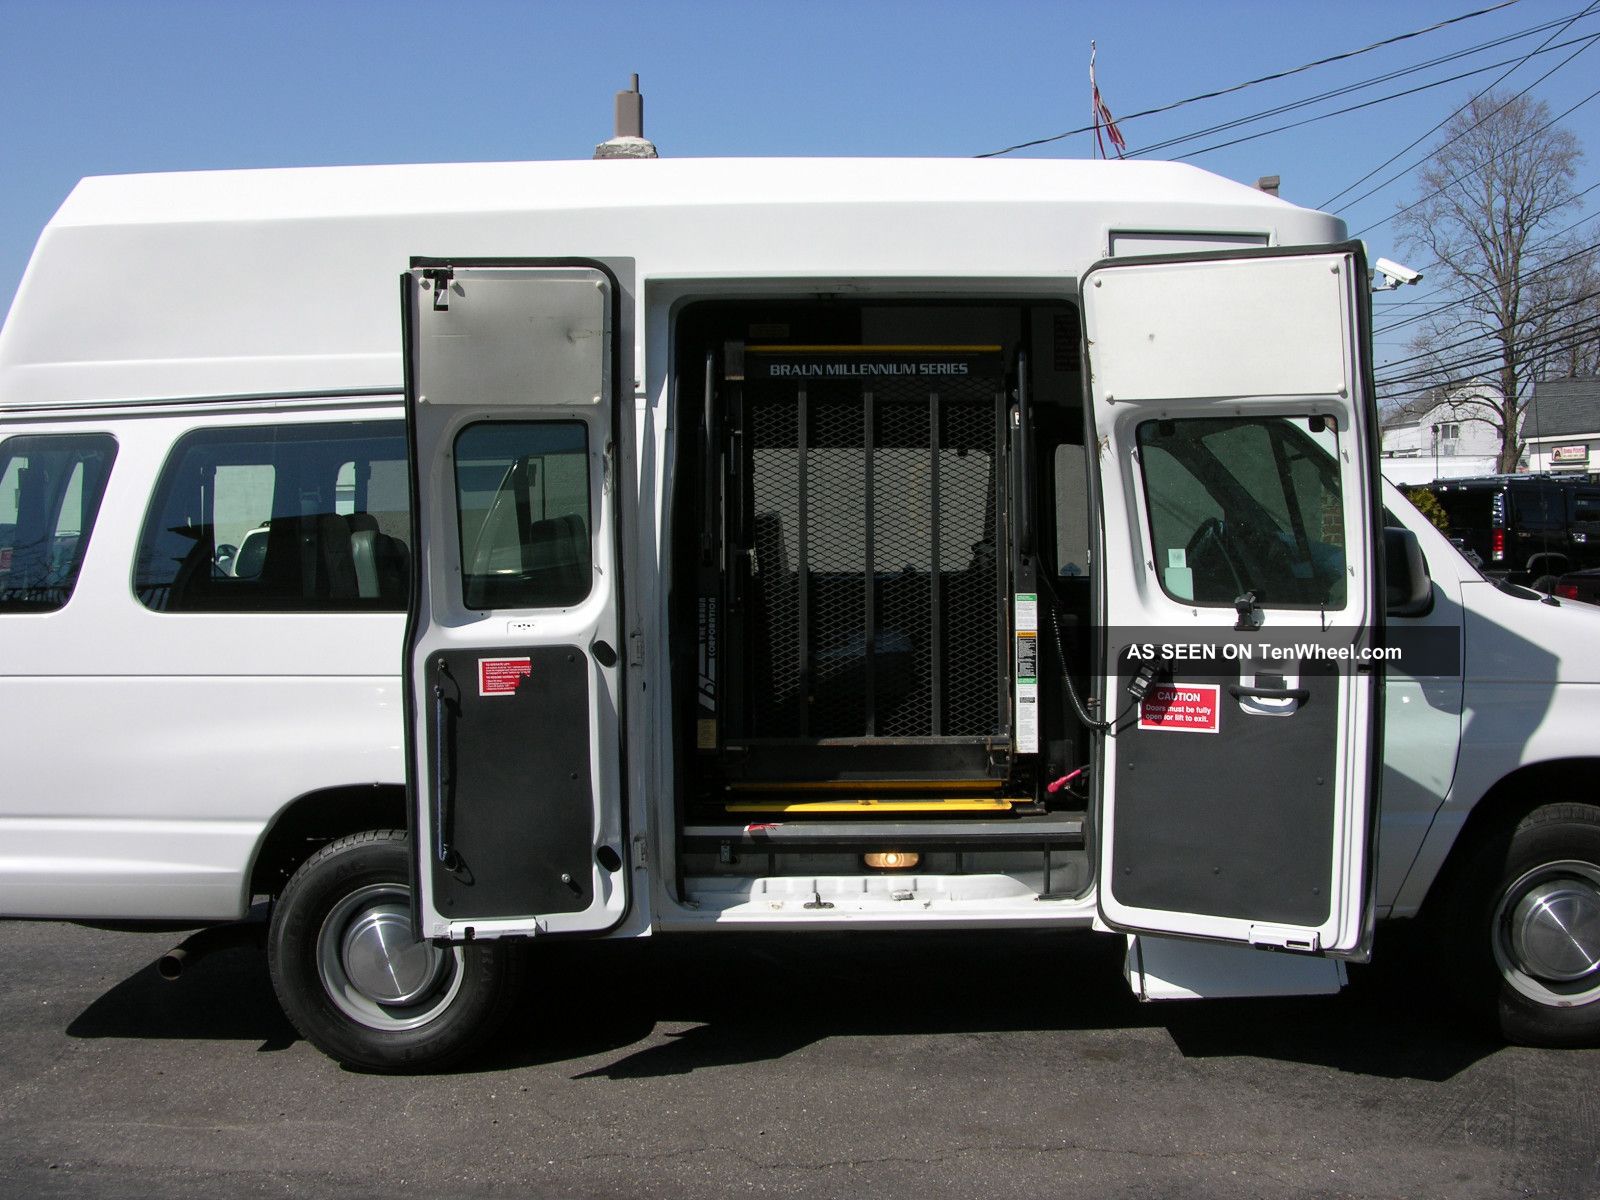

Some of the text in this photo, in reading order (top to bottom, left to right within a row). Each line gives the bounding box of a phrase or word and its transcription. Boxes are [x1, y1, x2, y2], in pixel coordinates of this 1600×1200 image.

[770, 363, 968, 376] BRAUN MILLENNIUM SERIES
[708, 597, 716, 657] CORPORATION
[1157, 692, 1200, 702] CAUTION
[1185, 705, 1194, 713] be
[1195, 706, 1211, 715] fully
[1146, 713, 1163, 721] open
[1175, 714, 1184, 722] lift
[1193, 715, 1209, 723] exit.
